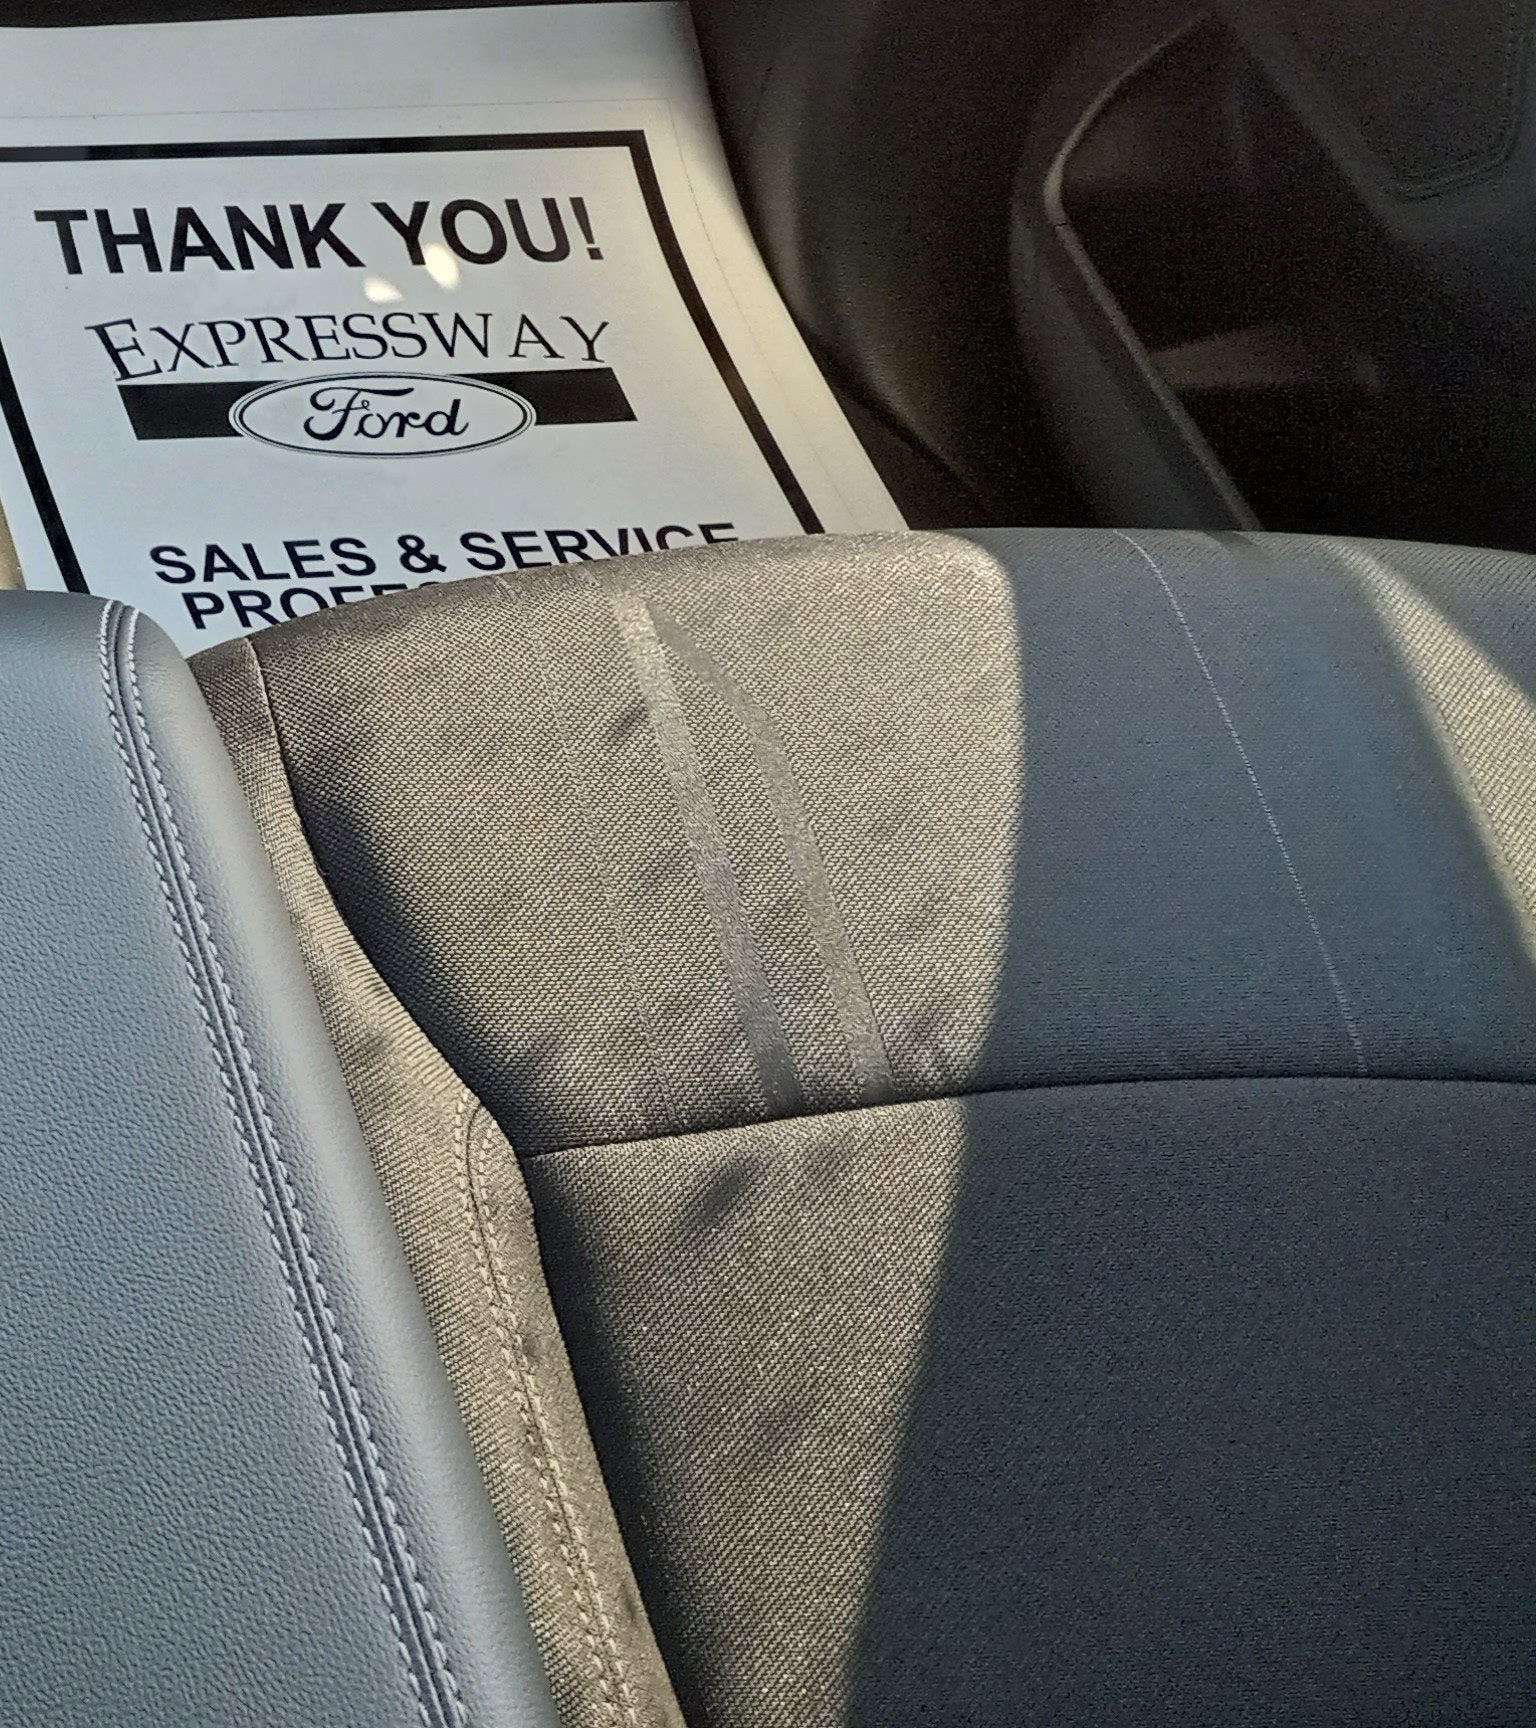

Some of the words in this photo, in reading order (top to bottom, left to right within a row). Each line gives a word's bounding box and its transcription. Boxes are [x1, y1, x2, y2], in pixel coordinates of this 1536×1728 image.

[33, 203, 366, 276] THANK
[372, 196, 603, 265] YOU!
[84, 311, 609, 380] EXPRESSWAY
[302, 385, 470, 441] Ford
[150, 537, 376, 583] SALES
[398, 534, 446, 572] &
